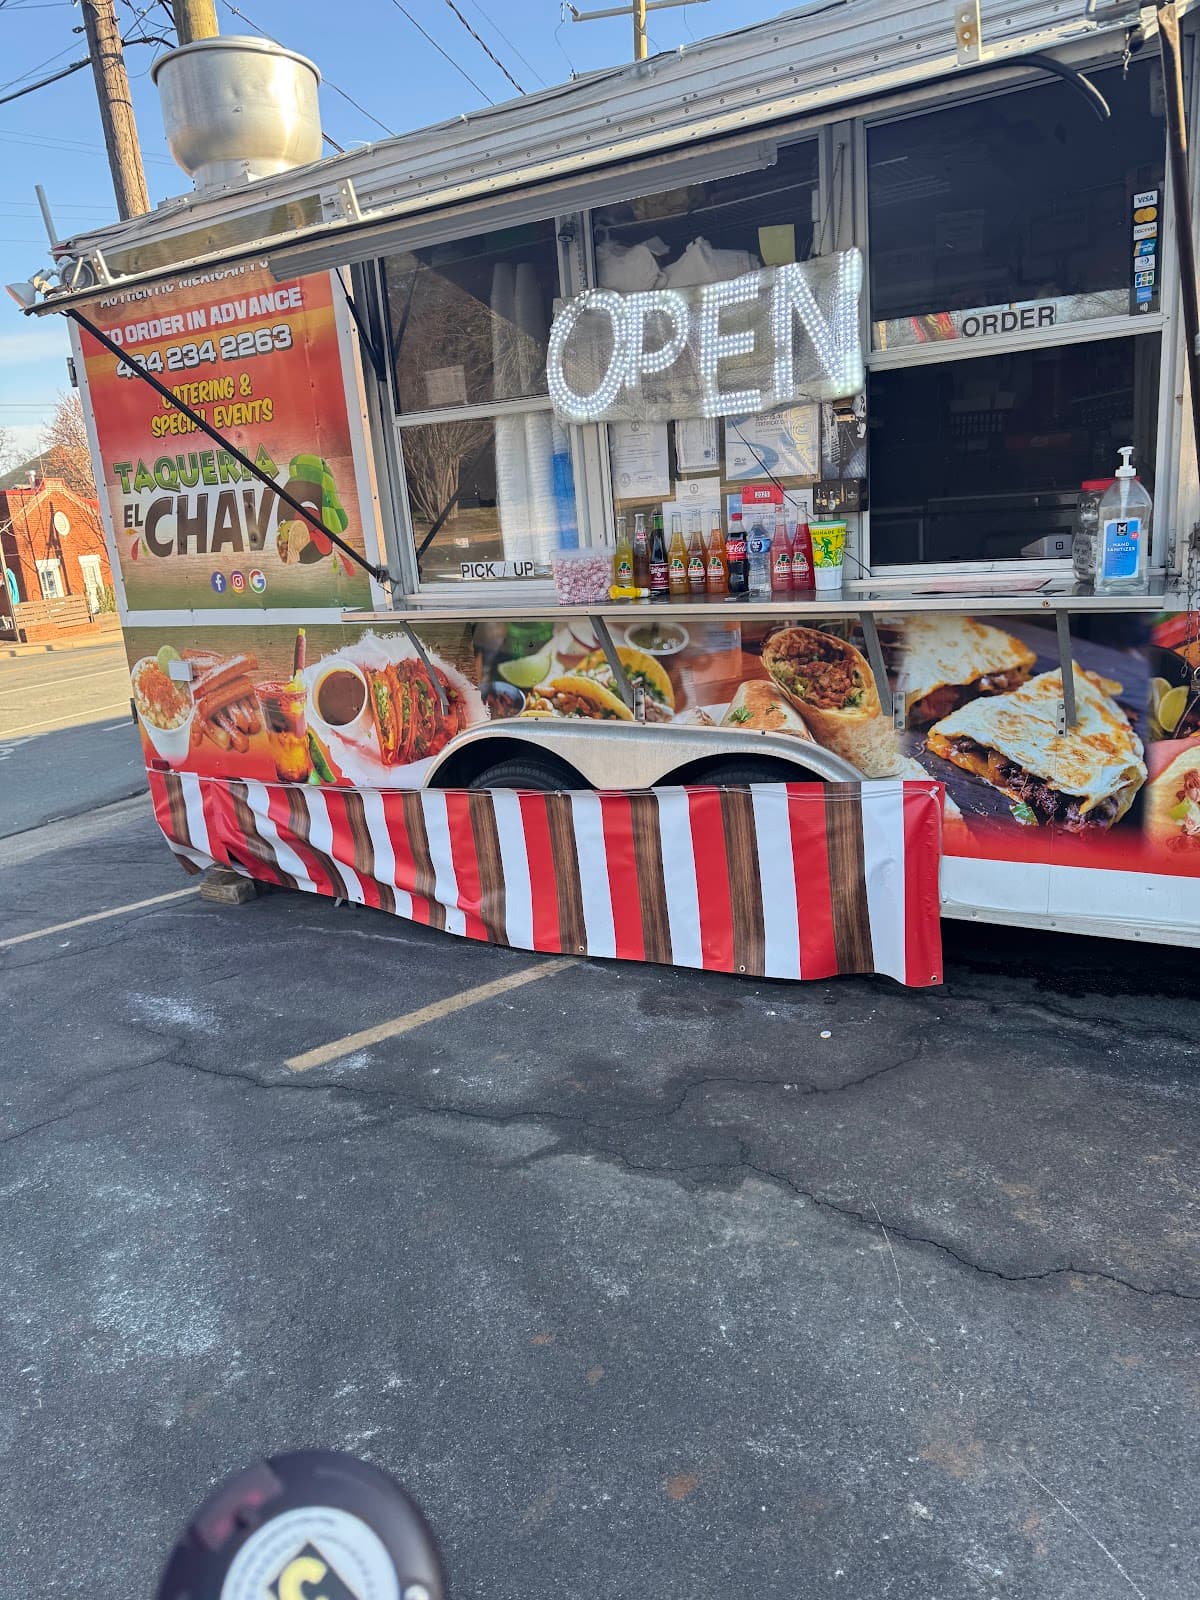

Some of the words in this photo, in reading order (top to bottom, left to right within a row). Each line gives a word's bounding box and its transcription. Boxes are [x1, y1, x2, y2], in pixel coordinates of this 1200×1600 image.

[1136, 194, 1154, 204] VISA
[125, 315, 185, 343] ORDER
[187, 309, 207, 330] IN
[210, 286, 303, 326] ADVANCE
[962, 305, 1055, 337] ORDER
[166, 340, 217, 371] 234
[219, 324, 293, 361] 2263
[546, 247, 865, 418] OPEN
[161, 376, 235, 410] CATERING
[238, 373, 252, 397] &
[213, 397, 274, 429] EVENTS
[113, 443, 280, 495] TAQUERIA
[123, 503, 144, 529] EL
[461, 563, 496, 578] PICK
[513, 561, 534, 576] UP
